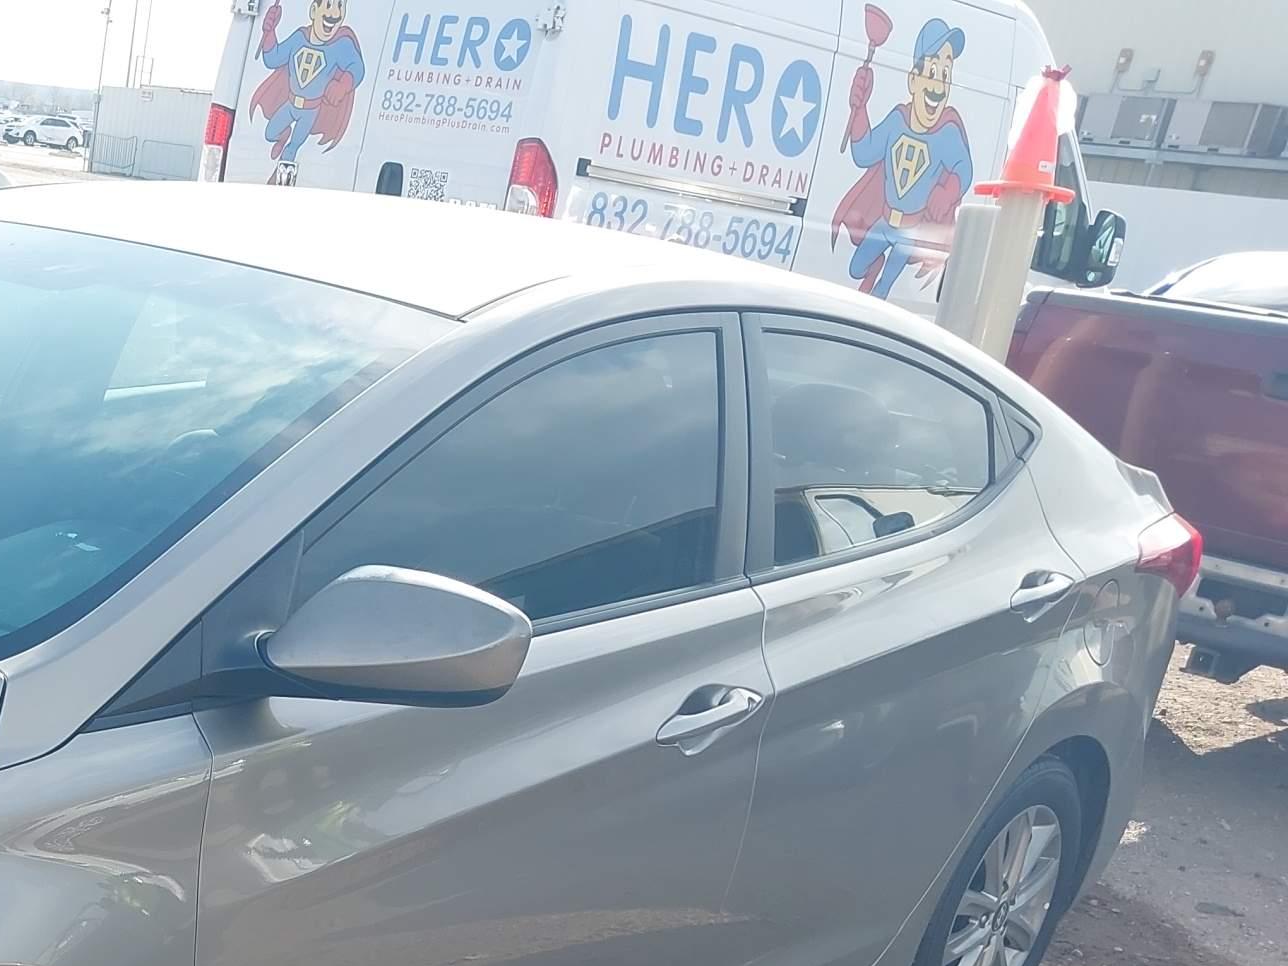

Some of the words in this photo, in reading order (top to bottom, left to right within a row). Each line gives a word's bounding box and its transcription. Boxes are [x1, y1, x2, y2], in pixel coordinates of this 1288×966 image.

[392, 13, 531, 71] HERO
[381, 89, 513, 122] 832-788-5694
[607, 14, 822, 157] HERO
